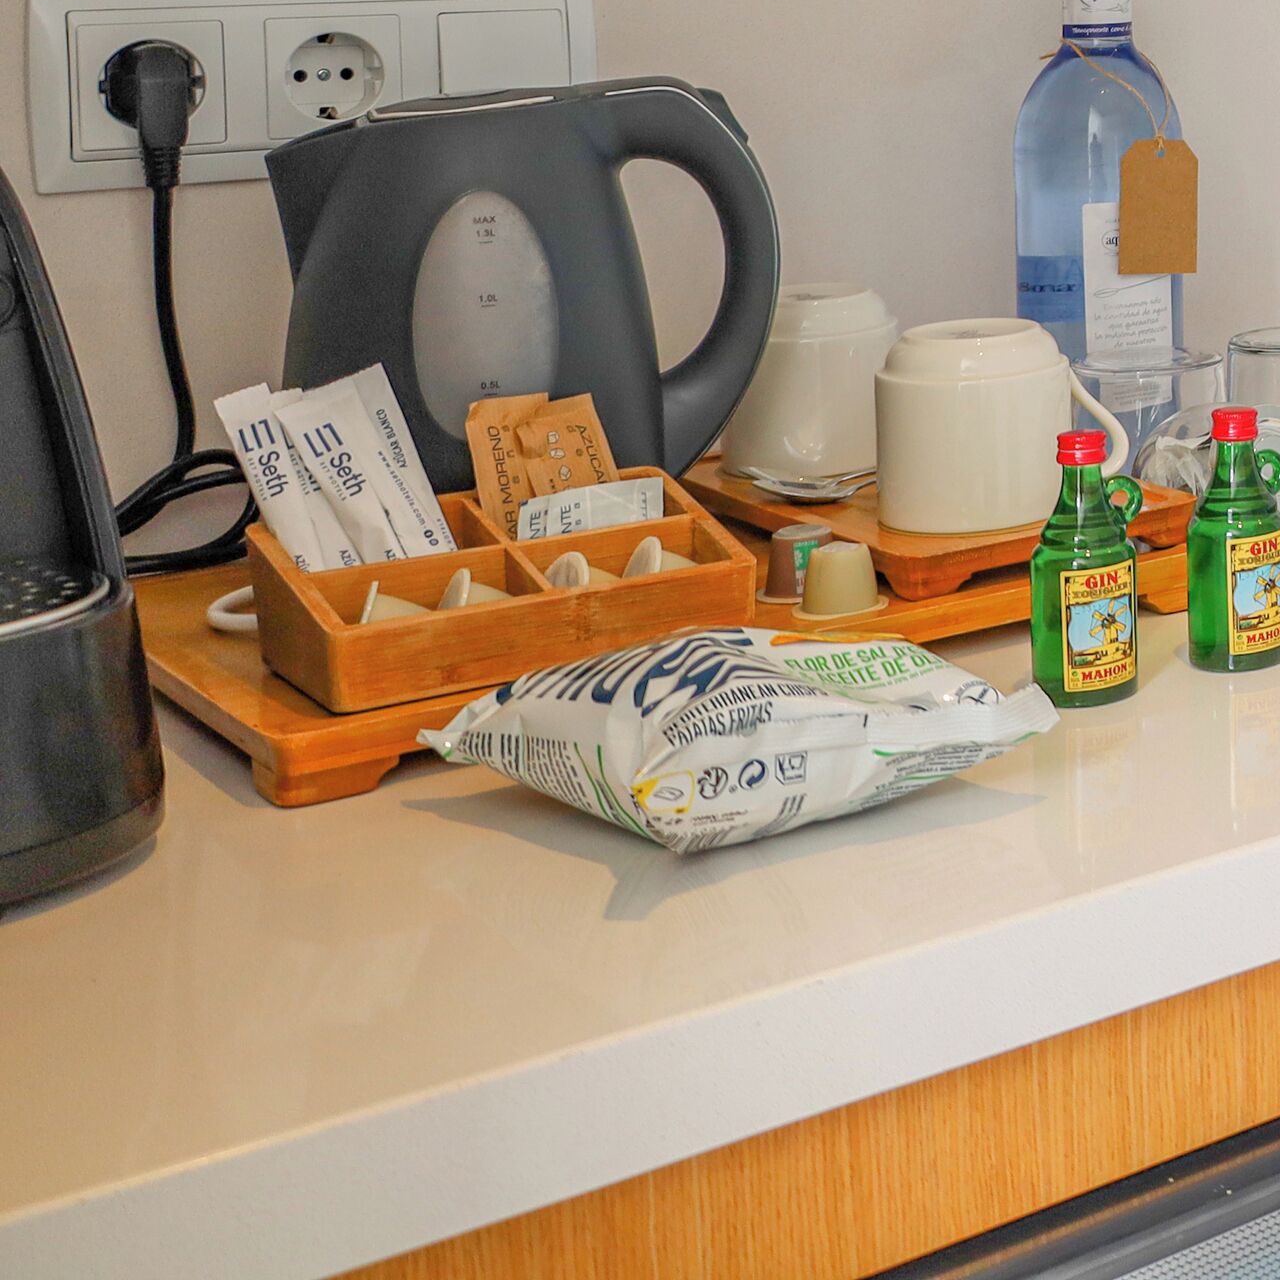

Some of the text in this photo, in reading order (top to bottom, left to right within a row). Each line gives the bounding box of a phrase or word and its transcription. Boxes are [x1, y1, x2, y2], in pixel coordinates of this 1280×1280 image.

[473, 216, 496, 224] MAX
[481, 381, 500, 390] 0.5L
[375, 408, 397, 440] BLANCO
[258, 450, 289, 498] Seth
[329, 451, 366, 497] Seth
[487, 425, 514, 505] MORENO
[1250, 538, 1278, 556] GIN
[1085, 570, 1119, 590] GIN
[784, 655, 831, 672] FLOR
[831, 652, 857, 670] DE
[856, 646, 887, 663] SAL
[817, 664, 881, 685] ACEITE
[881, 658, 909, 677] DE
[1081, 662, 1128, 681] MAHON
